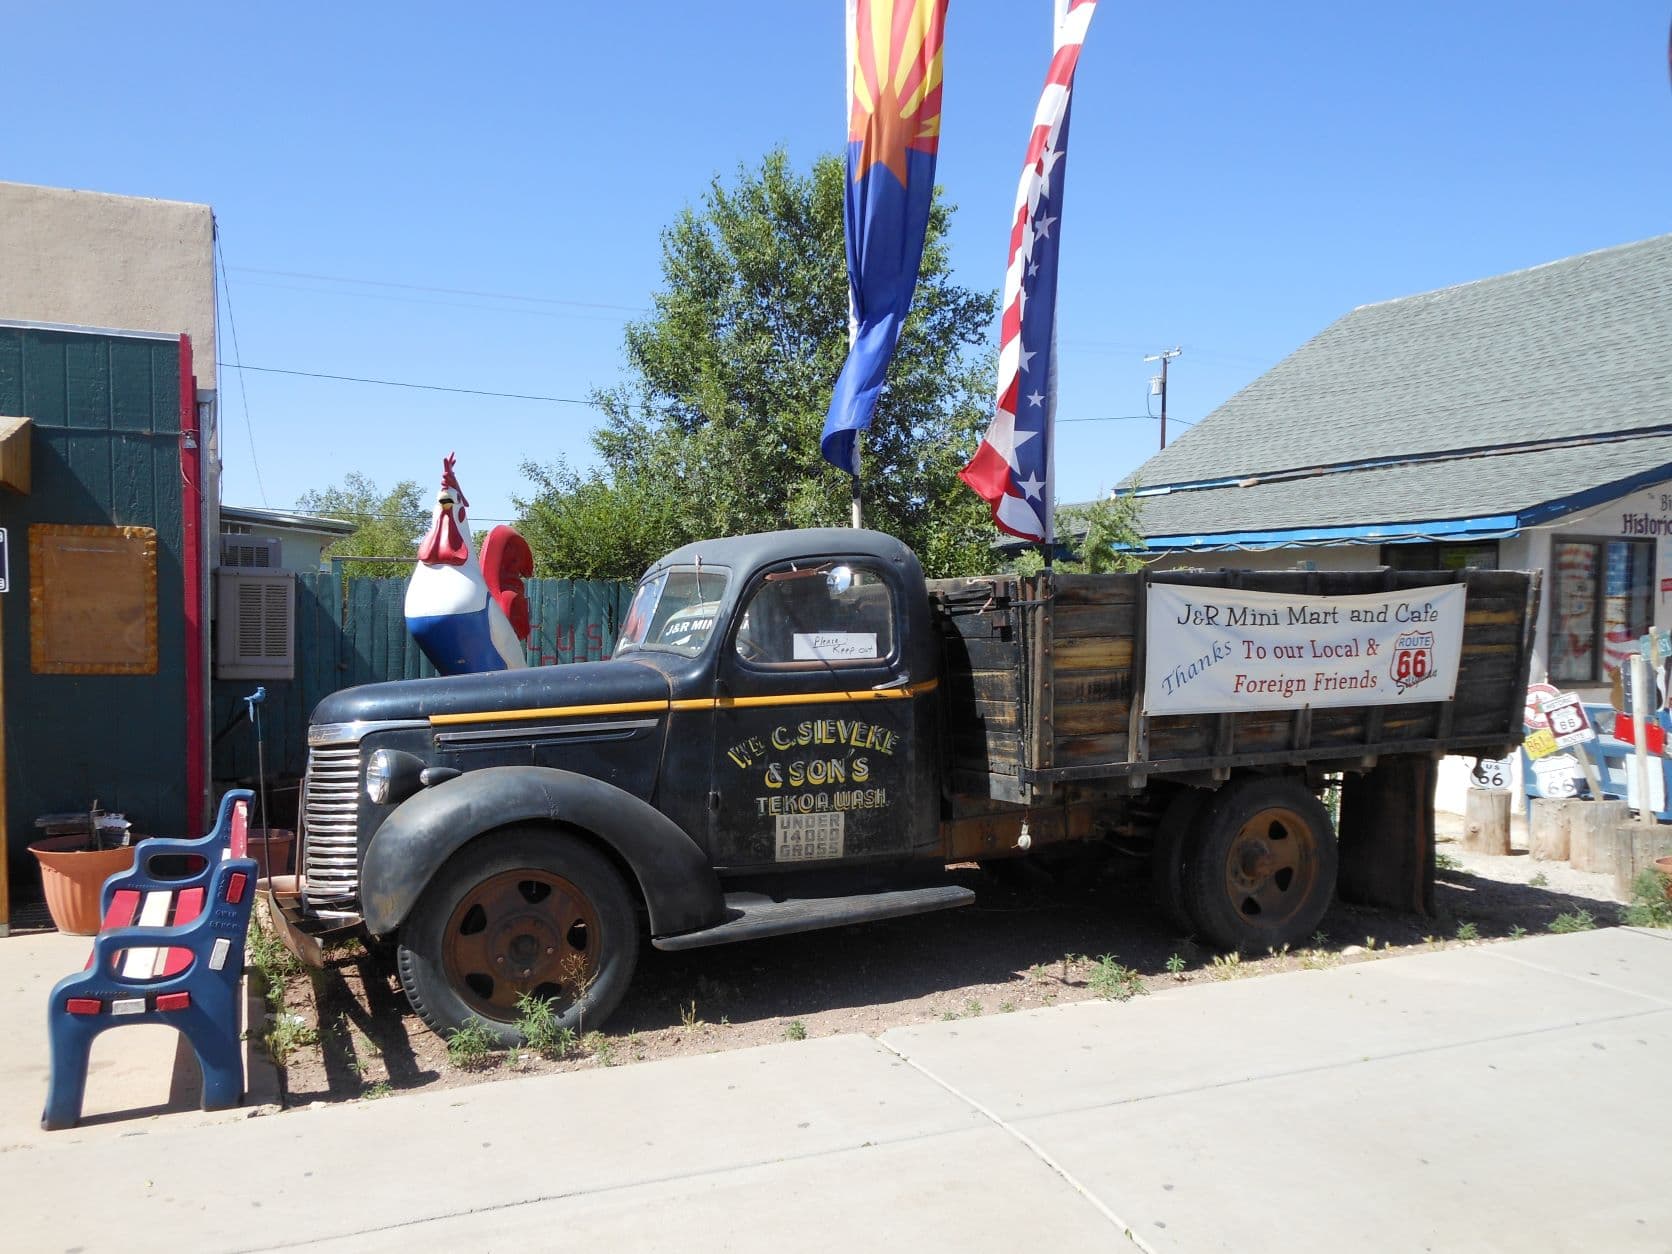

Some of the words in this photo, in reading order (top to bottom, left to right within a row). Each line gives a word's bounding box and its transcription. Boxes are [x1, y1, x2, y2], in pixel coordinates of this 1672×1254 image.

[1621, 513, 1672, 535] Historic
[1177, 604, 1219, 625] J&R
[1225, 607, 1280, 626] Mini
[1286, 606, 1339, 625] Mart
[1349, 604, 1388, 623] and
[1395, 603, 1439, 623] Cafe
[526, 623, 624, 651] CUS
[665, 621, 691, 636] J&R
[691, 618, 714, 631] MIN
[813, 636, 839, 647] Please
[832, 645, 855, 655] Keep
[1242, 640, 1267, 660] To
[1273, 645, 1304, 659] our
[1310, 638, 1360, 659] Local
[1366, 638, 1380, 656] &
[1399, 636, 1431, 647] ROUTE
[1161, 640, 1232, 695] Thanks
[1397, 650, 1427, 678] 66
[1233, 675, 1307, 698] Foreign
[1313, 670, 1377, 691] Friends
[764, 762, 783, 789] &
[1479, 772, 1504, 787] 66
